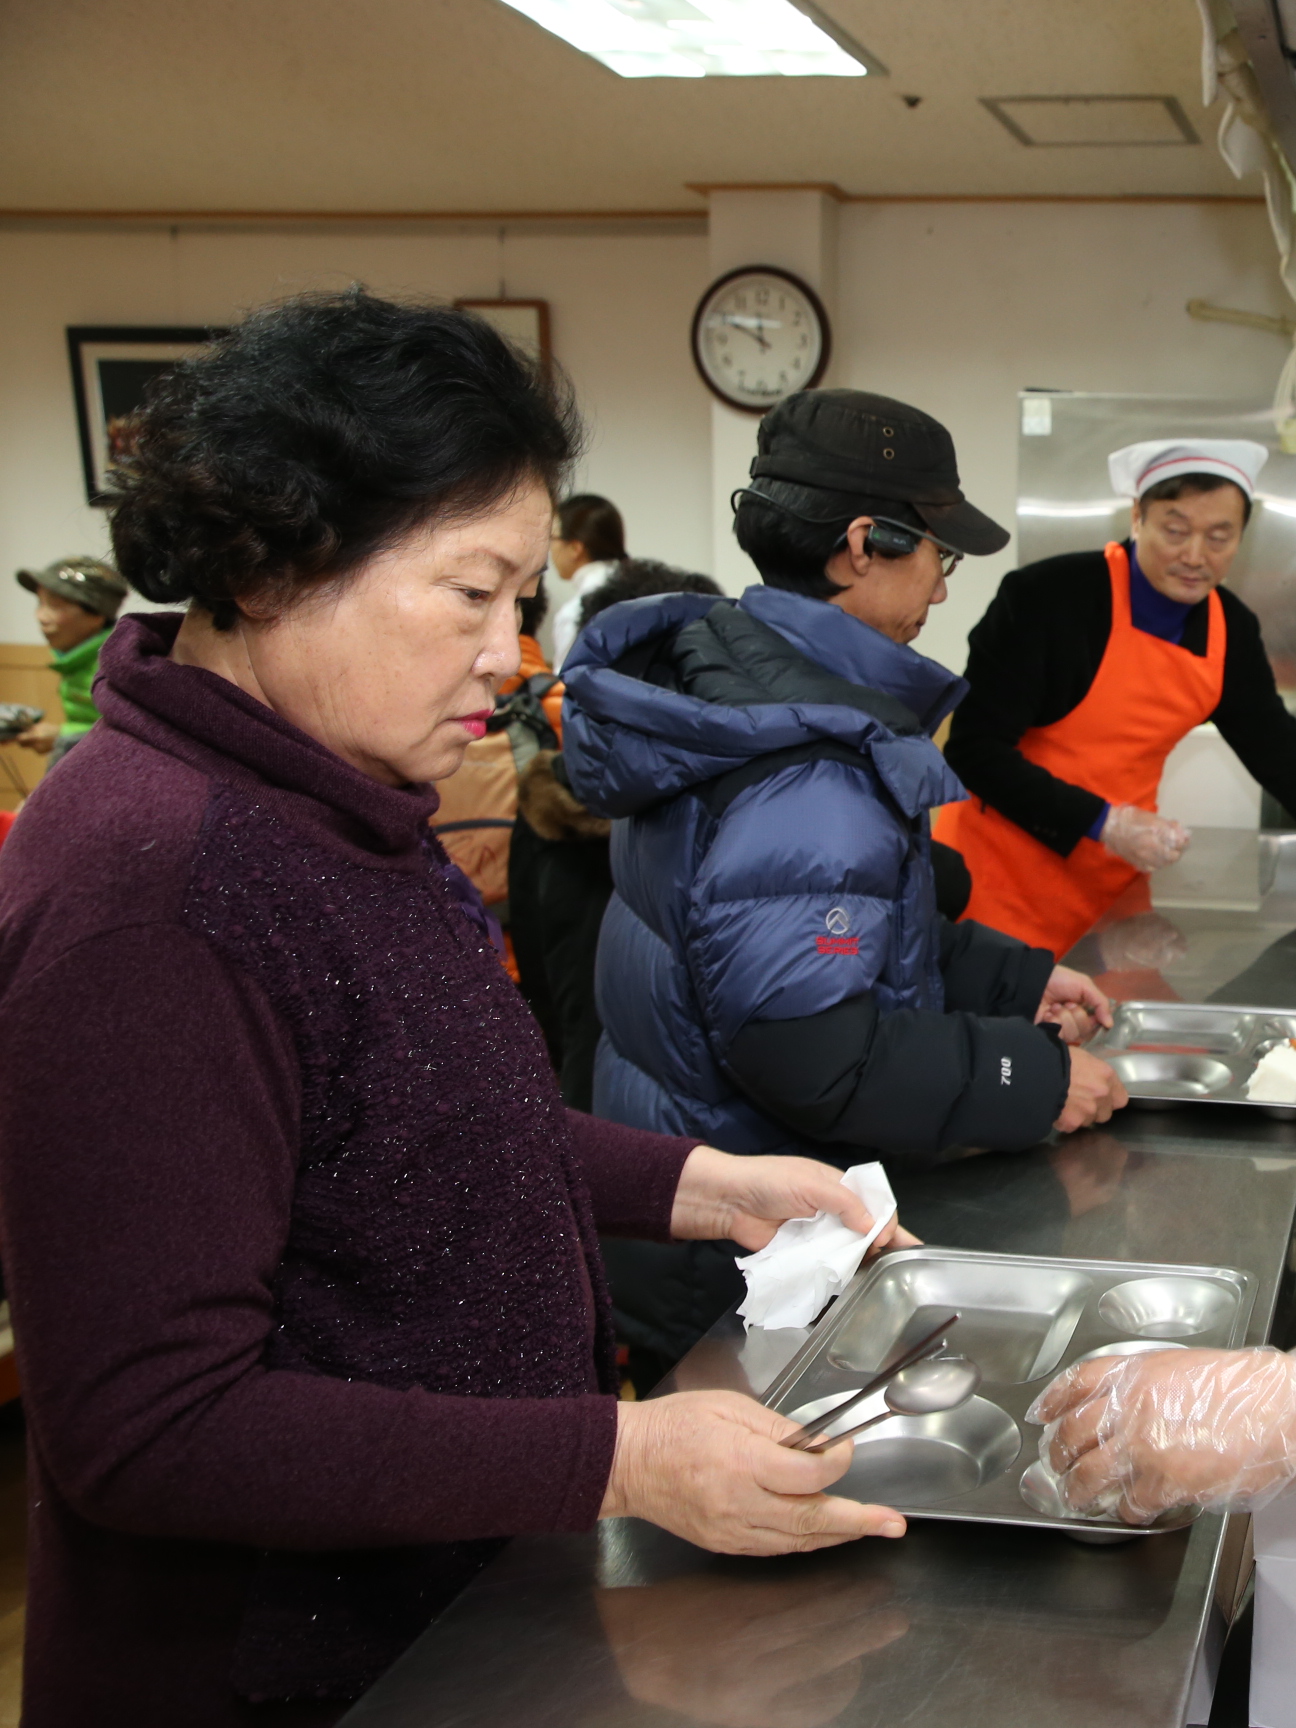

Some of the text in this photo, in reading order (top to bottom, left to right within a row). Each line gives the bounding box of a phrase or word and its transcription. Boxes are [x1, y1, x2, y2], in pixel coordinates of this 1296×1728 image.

[815, 935, 859, 946] SUMMIT
[817, 945, 859, 956] SERIES
[1001, 1056, 1012, 1086] 700
